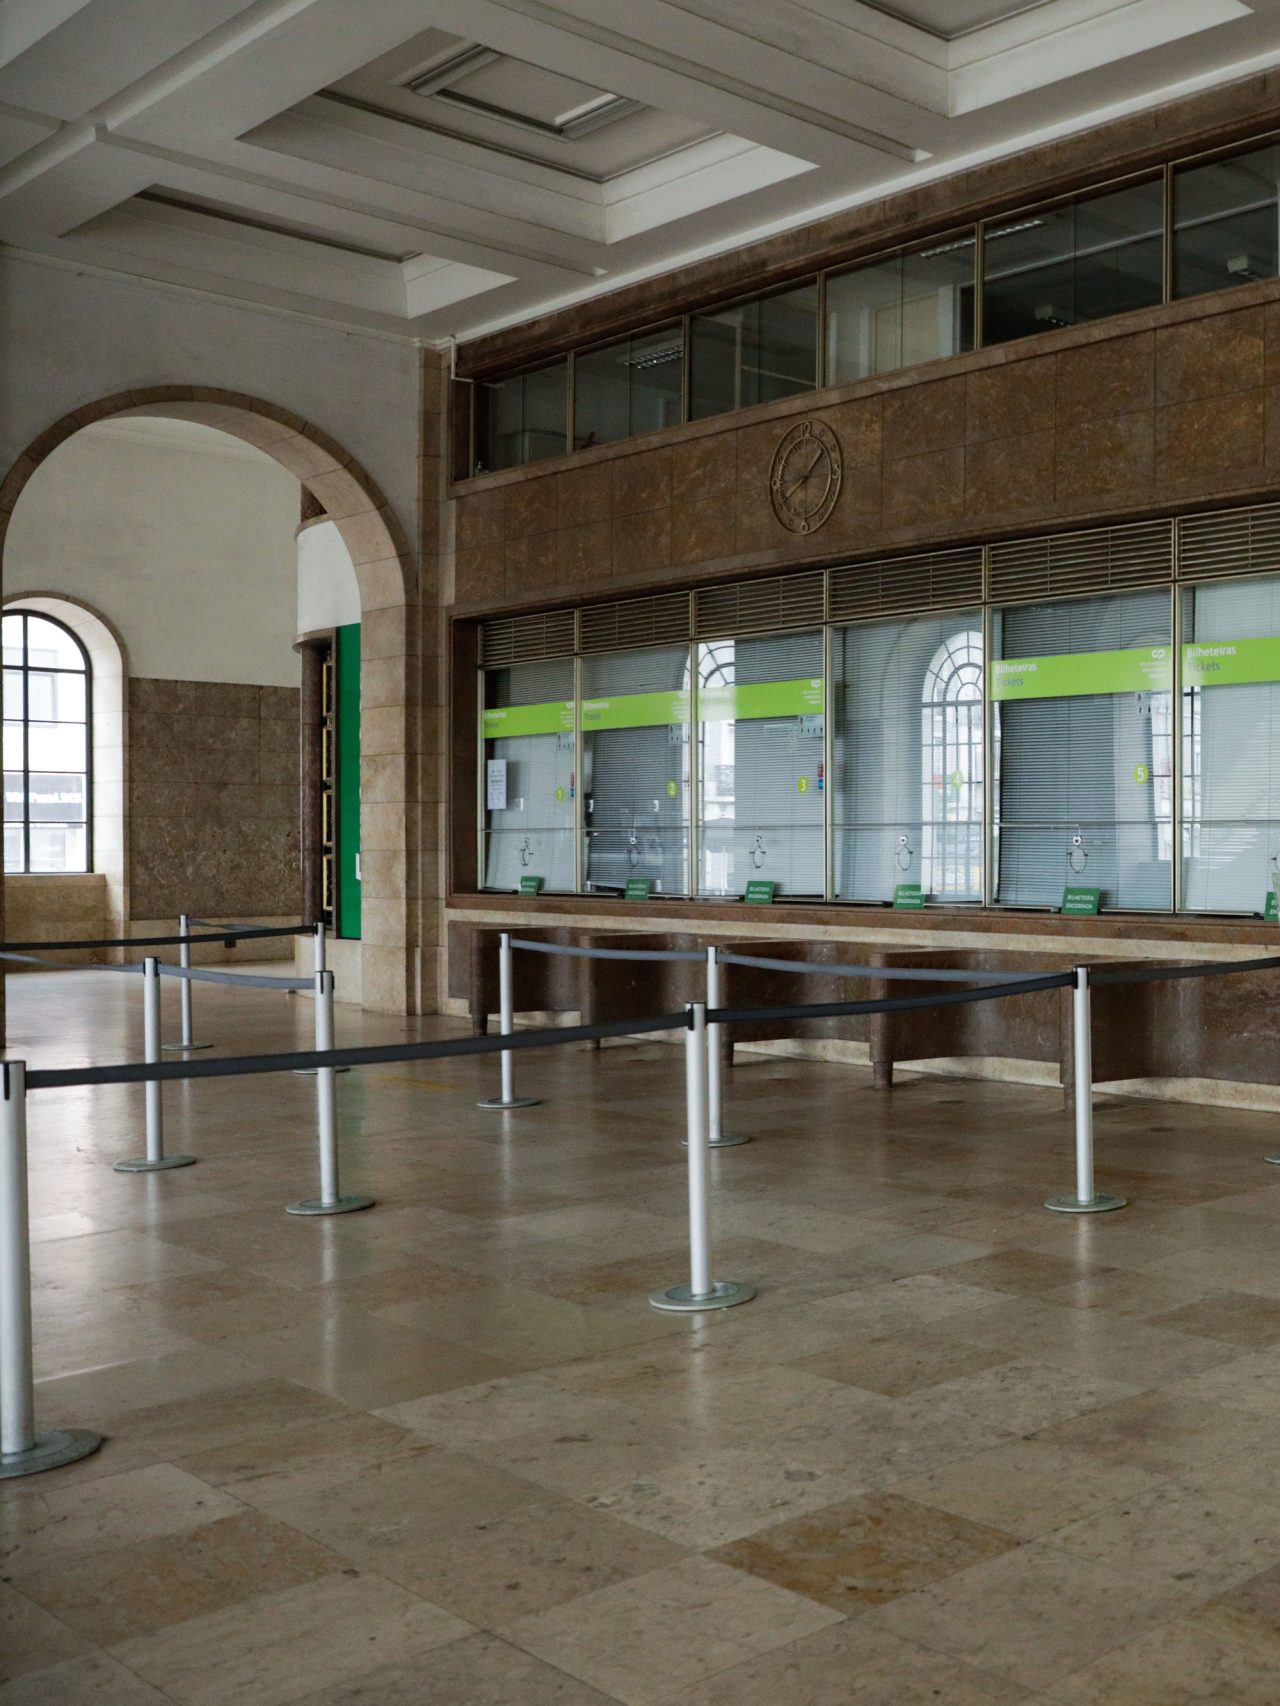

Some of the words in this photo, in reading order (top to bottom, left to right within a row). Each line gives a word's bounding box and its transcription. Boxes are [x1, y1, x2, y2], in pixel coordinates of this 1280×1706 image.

[1187, 646, 1237, 657] Bilheteiras
[995, 663, 1038, 674] Bilheteiras
[1188, 662, 1221, 672] Tickets
[996, 678, 1024, 687] Tickets
[1137, 768, 1143, 781] 5
